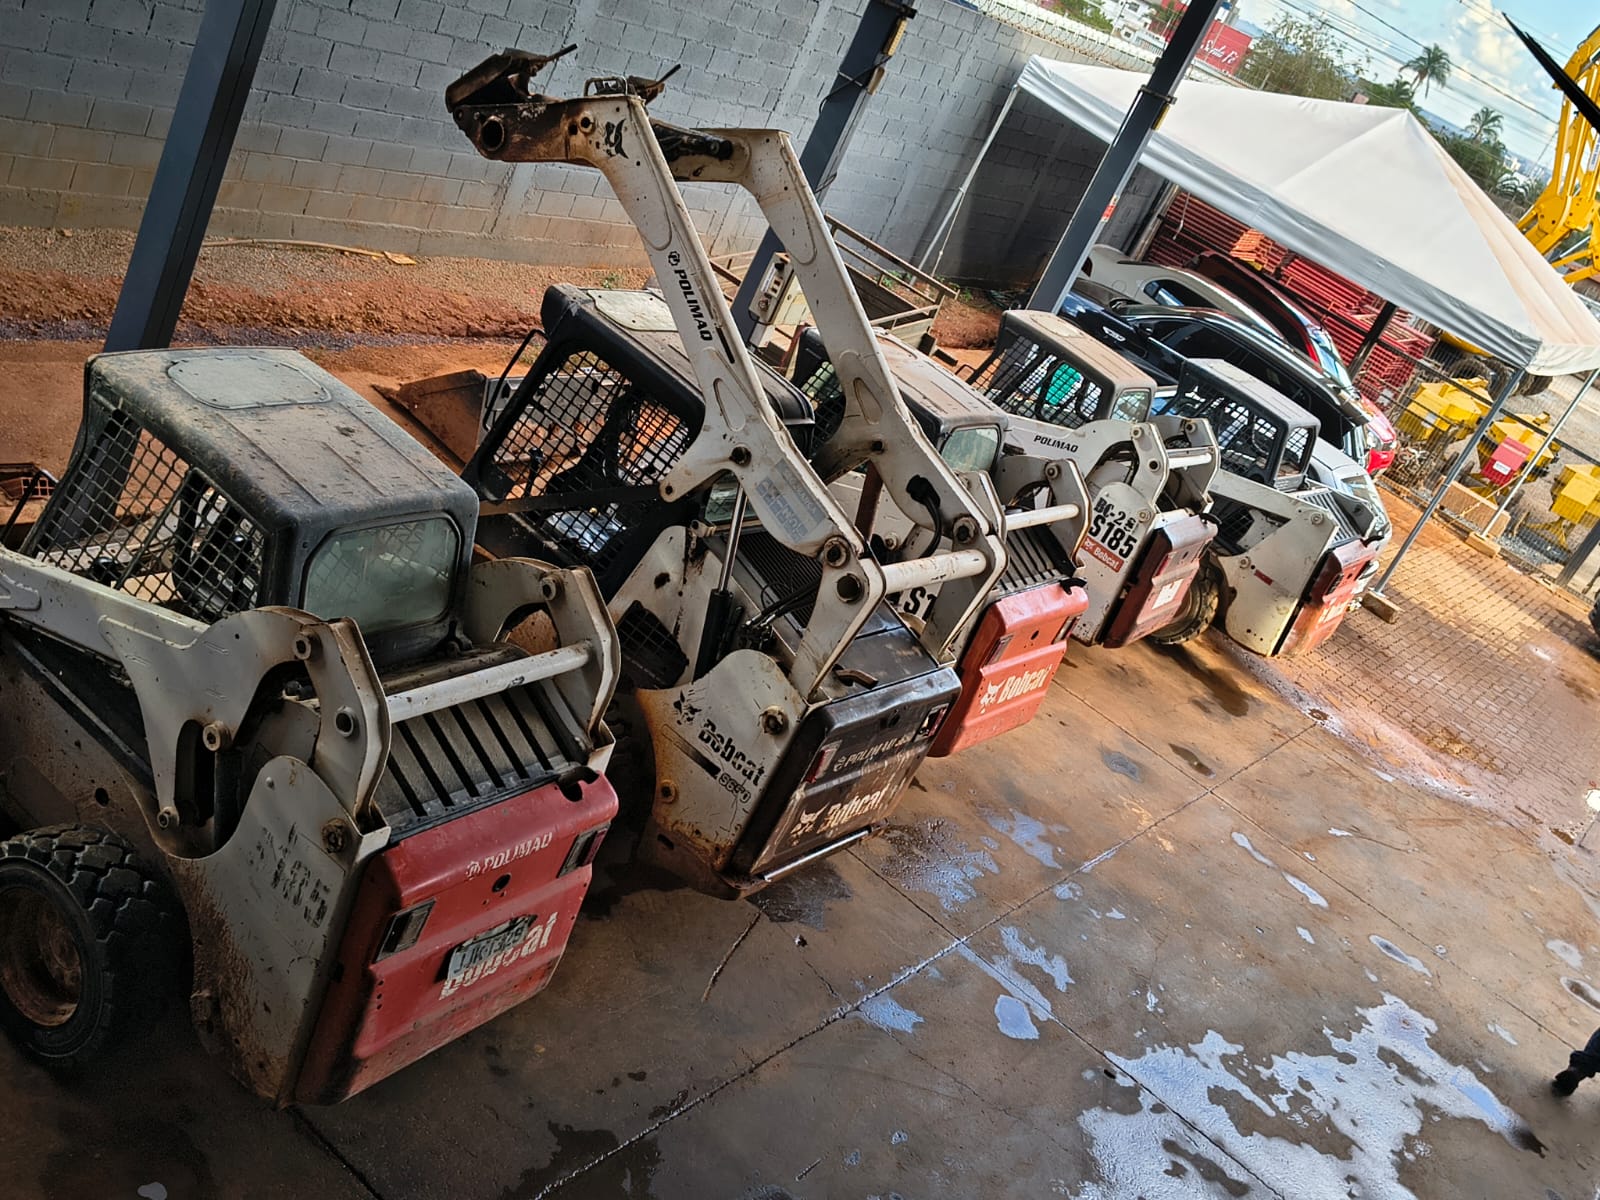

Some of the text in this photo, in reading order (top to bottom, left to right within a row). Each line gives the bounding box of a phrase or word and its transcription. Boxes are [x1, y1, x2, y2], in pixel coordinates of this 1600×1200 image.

[1089, 515, 1138, 559] S185
[1093, 545, 1122, 571] Bobcat
[997, 664, 1053, 705] Bobcat
[698, 718, 765, 786] Bobcat
